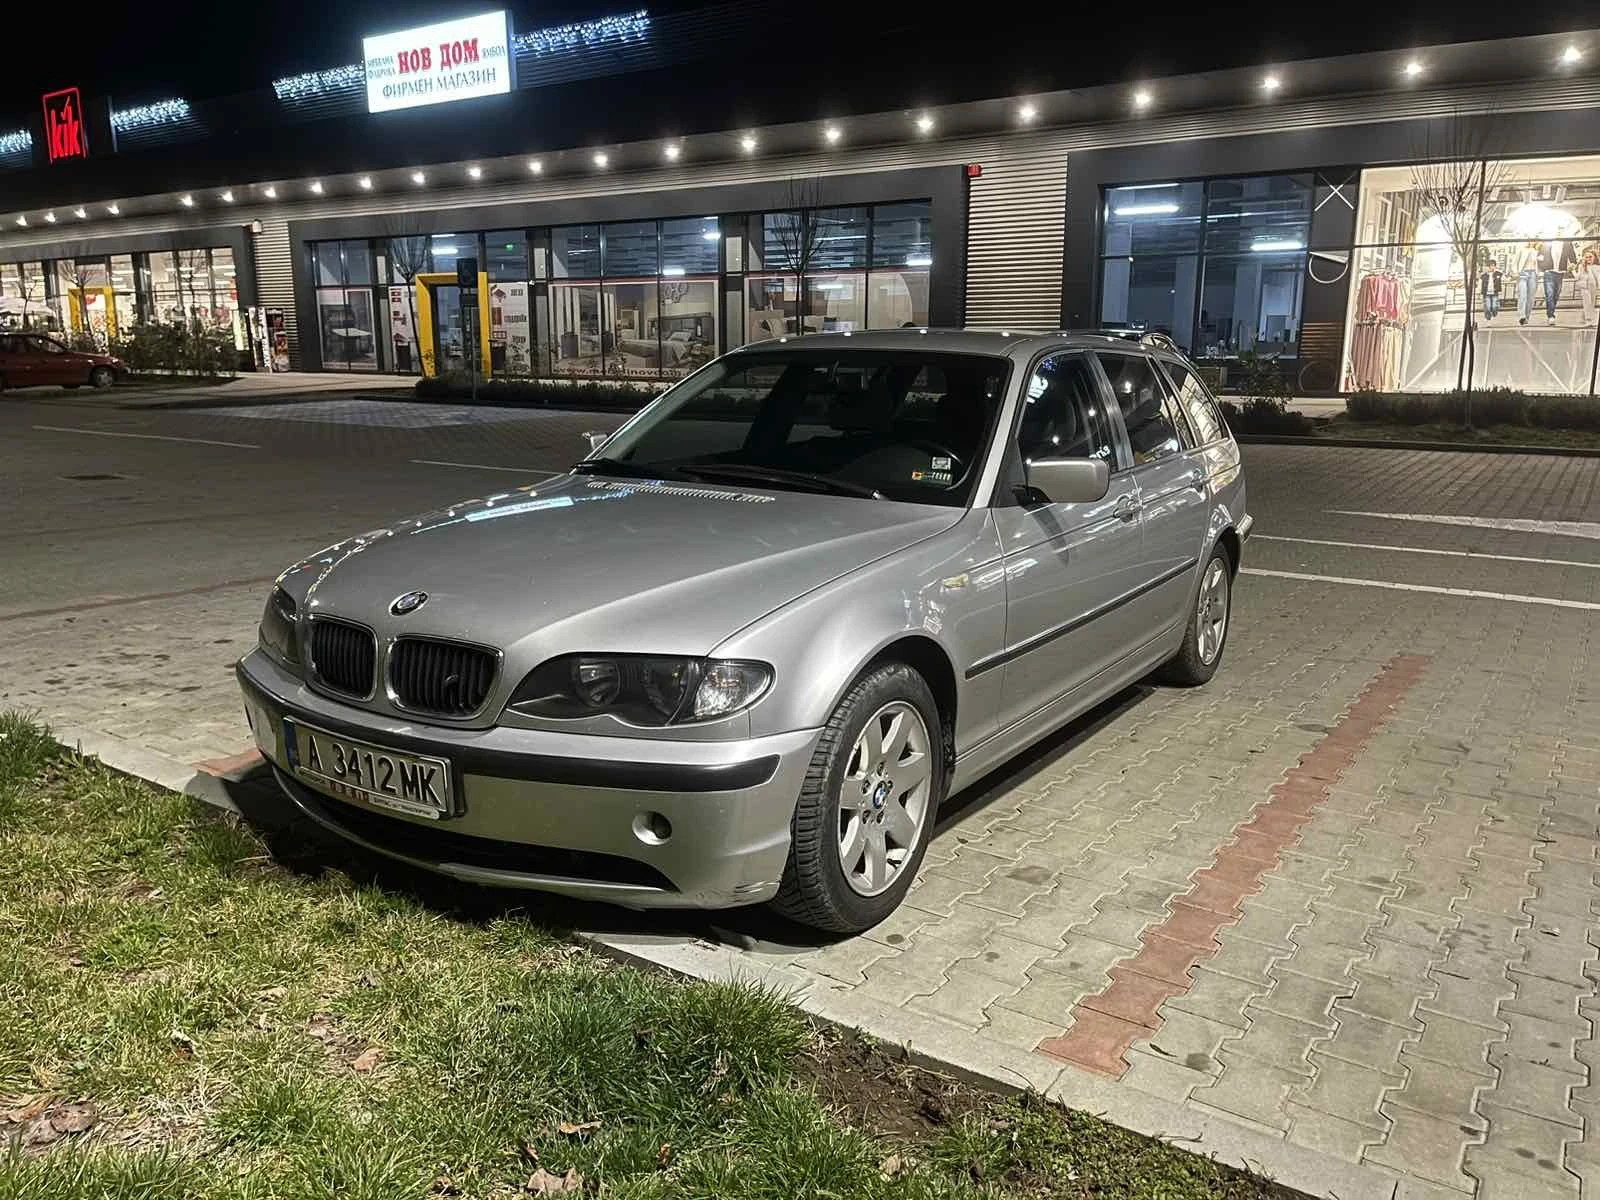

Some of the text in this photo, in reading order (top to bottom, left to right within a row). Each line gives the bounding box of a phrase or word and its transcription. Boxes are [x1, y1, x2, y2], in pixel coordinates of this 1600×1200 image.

[397, 37, 480, 74] НОВ ДОМ
[382, 67, 497, 98] ФИРМЕН МАГАЗИН
